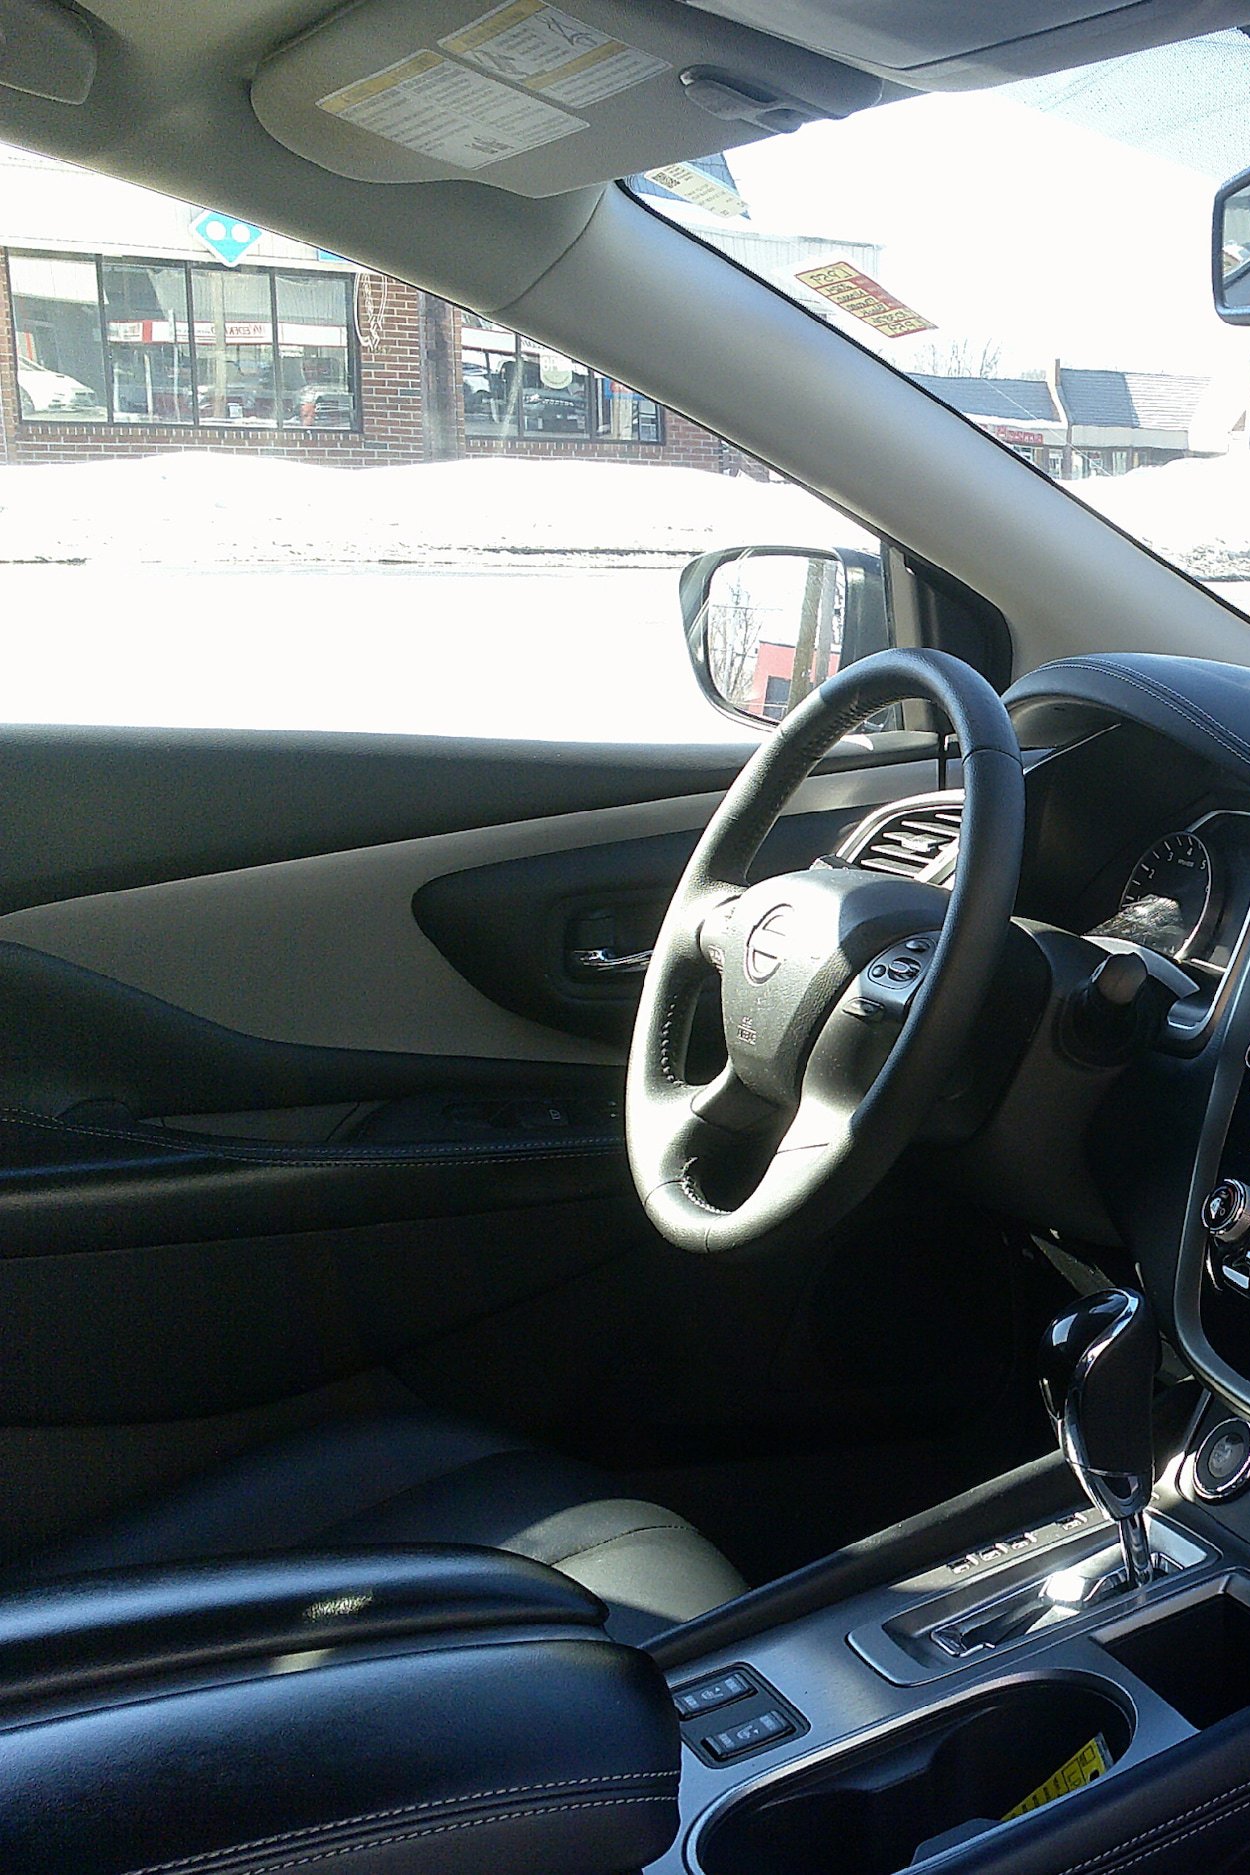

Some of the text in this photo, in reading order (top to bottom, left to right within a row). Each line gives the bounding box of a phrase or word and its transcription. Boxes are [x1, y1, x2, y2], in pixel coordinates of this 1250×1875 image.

[1168, 852, 1173, 861] 3
[1200, 860, 1206, 869] 5
[1149, 869, 1155, 879] 2
